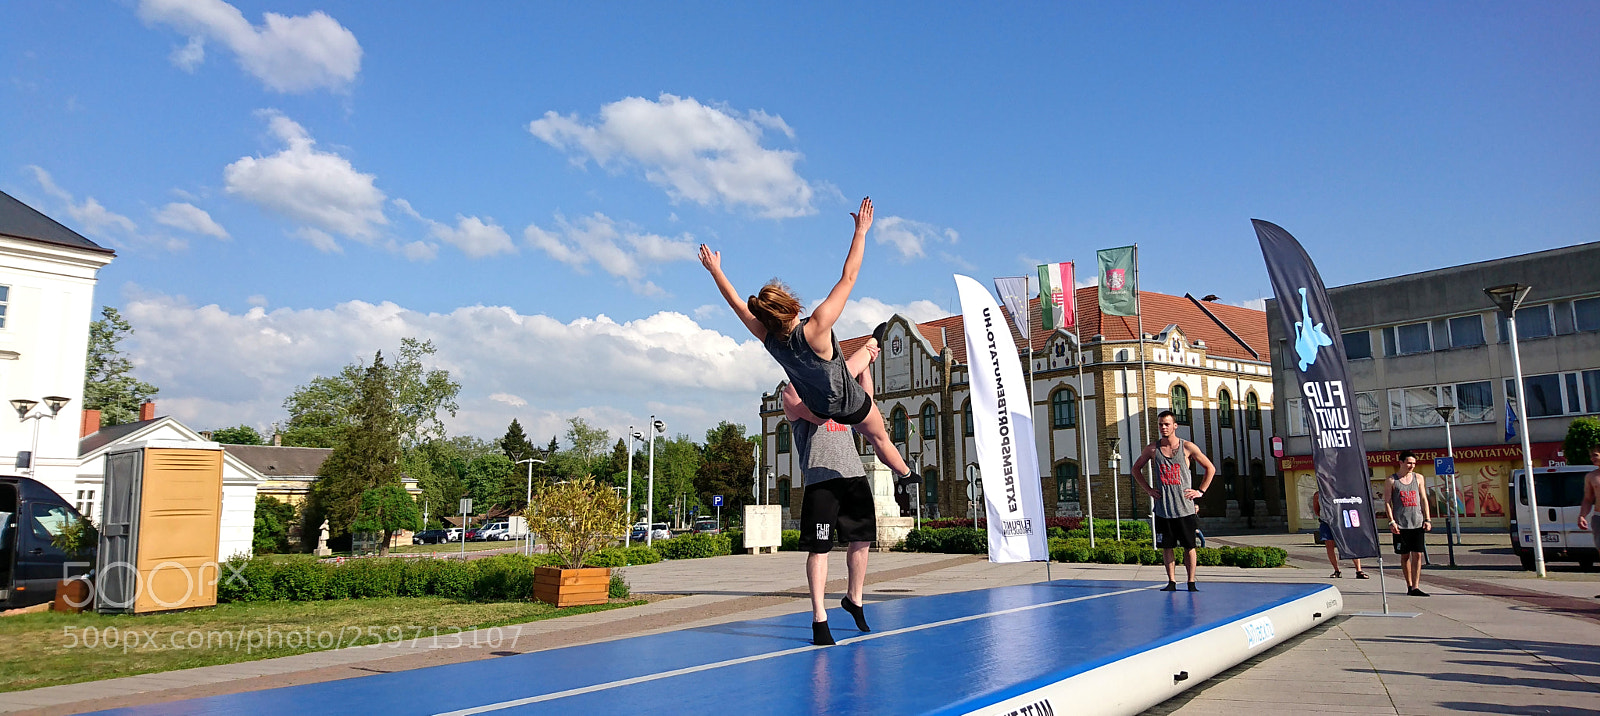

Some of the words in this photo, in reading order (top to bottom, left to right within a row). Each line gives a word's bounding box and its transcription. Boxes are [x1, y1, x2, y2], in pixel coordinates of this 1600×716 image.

[1452, 445, 1530, 459] NYOMTATVÁN
[1436, 459, 1443, 467] P
[1160, 463, 1180, 472] FLIP
[714, 496, 721, 504] P
[816, 523, 830, 531] FLIP
